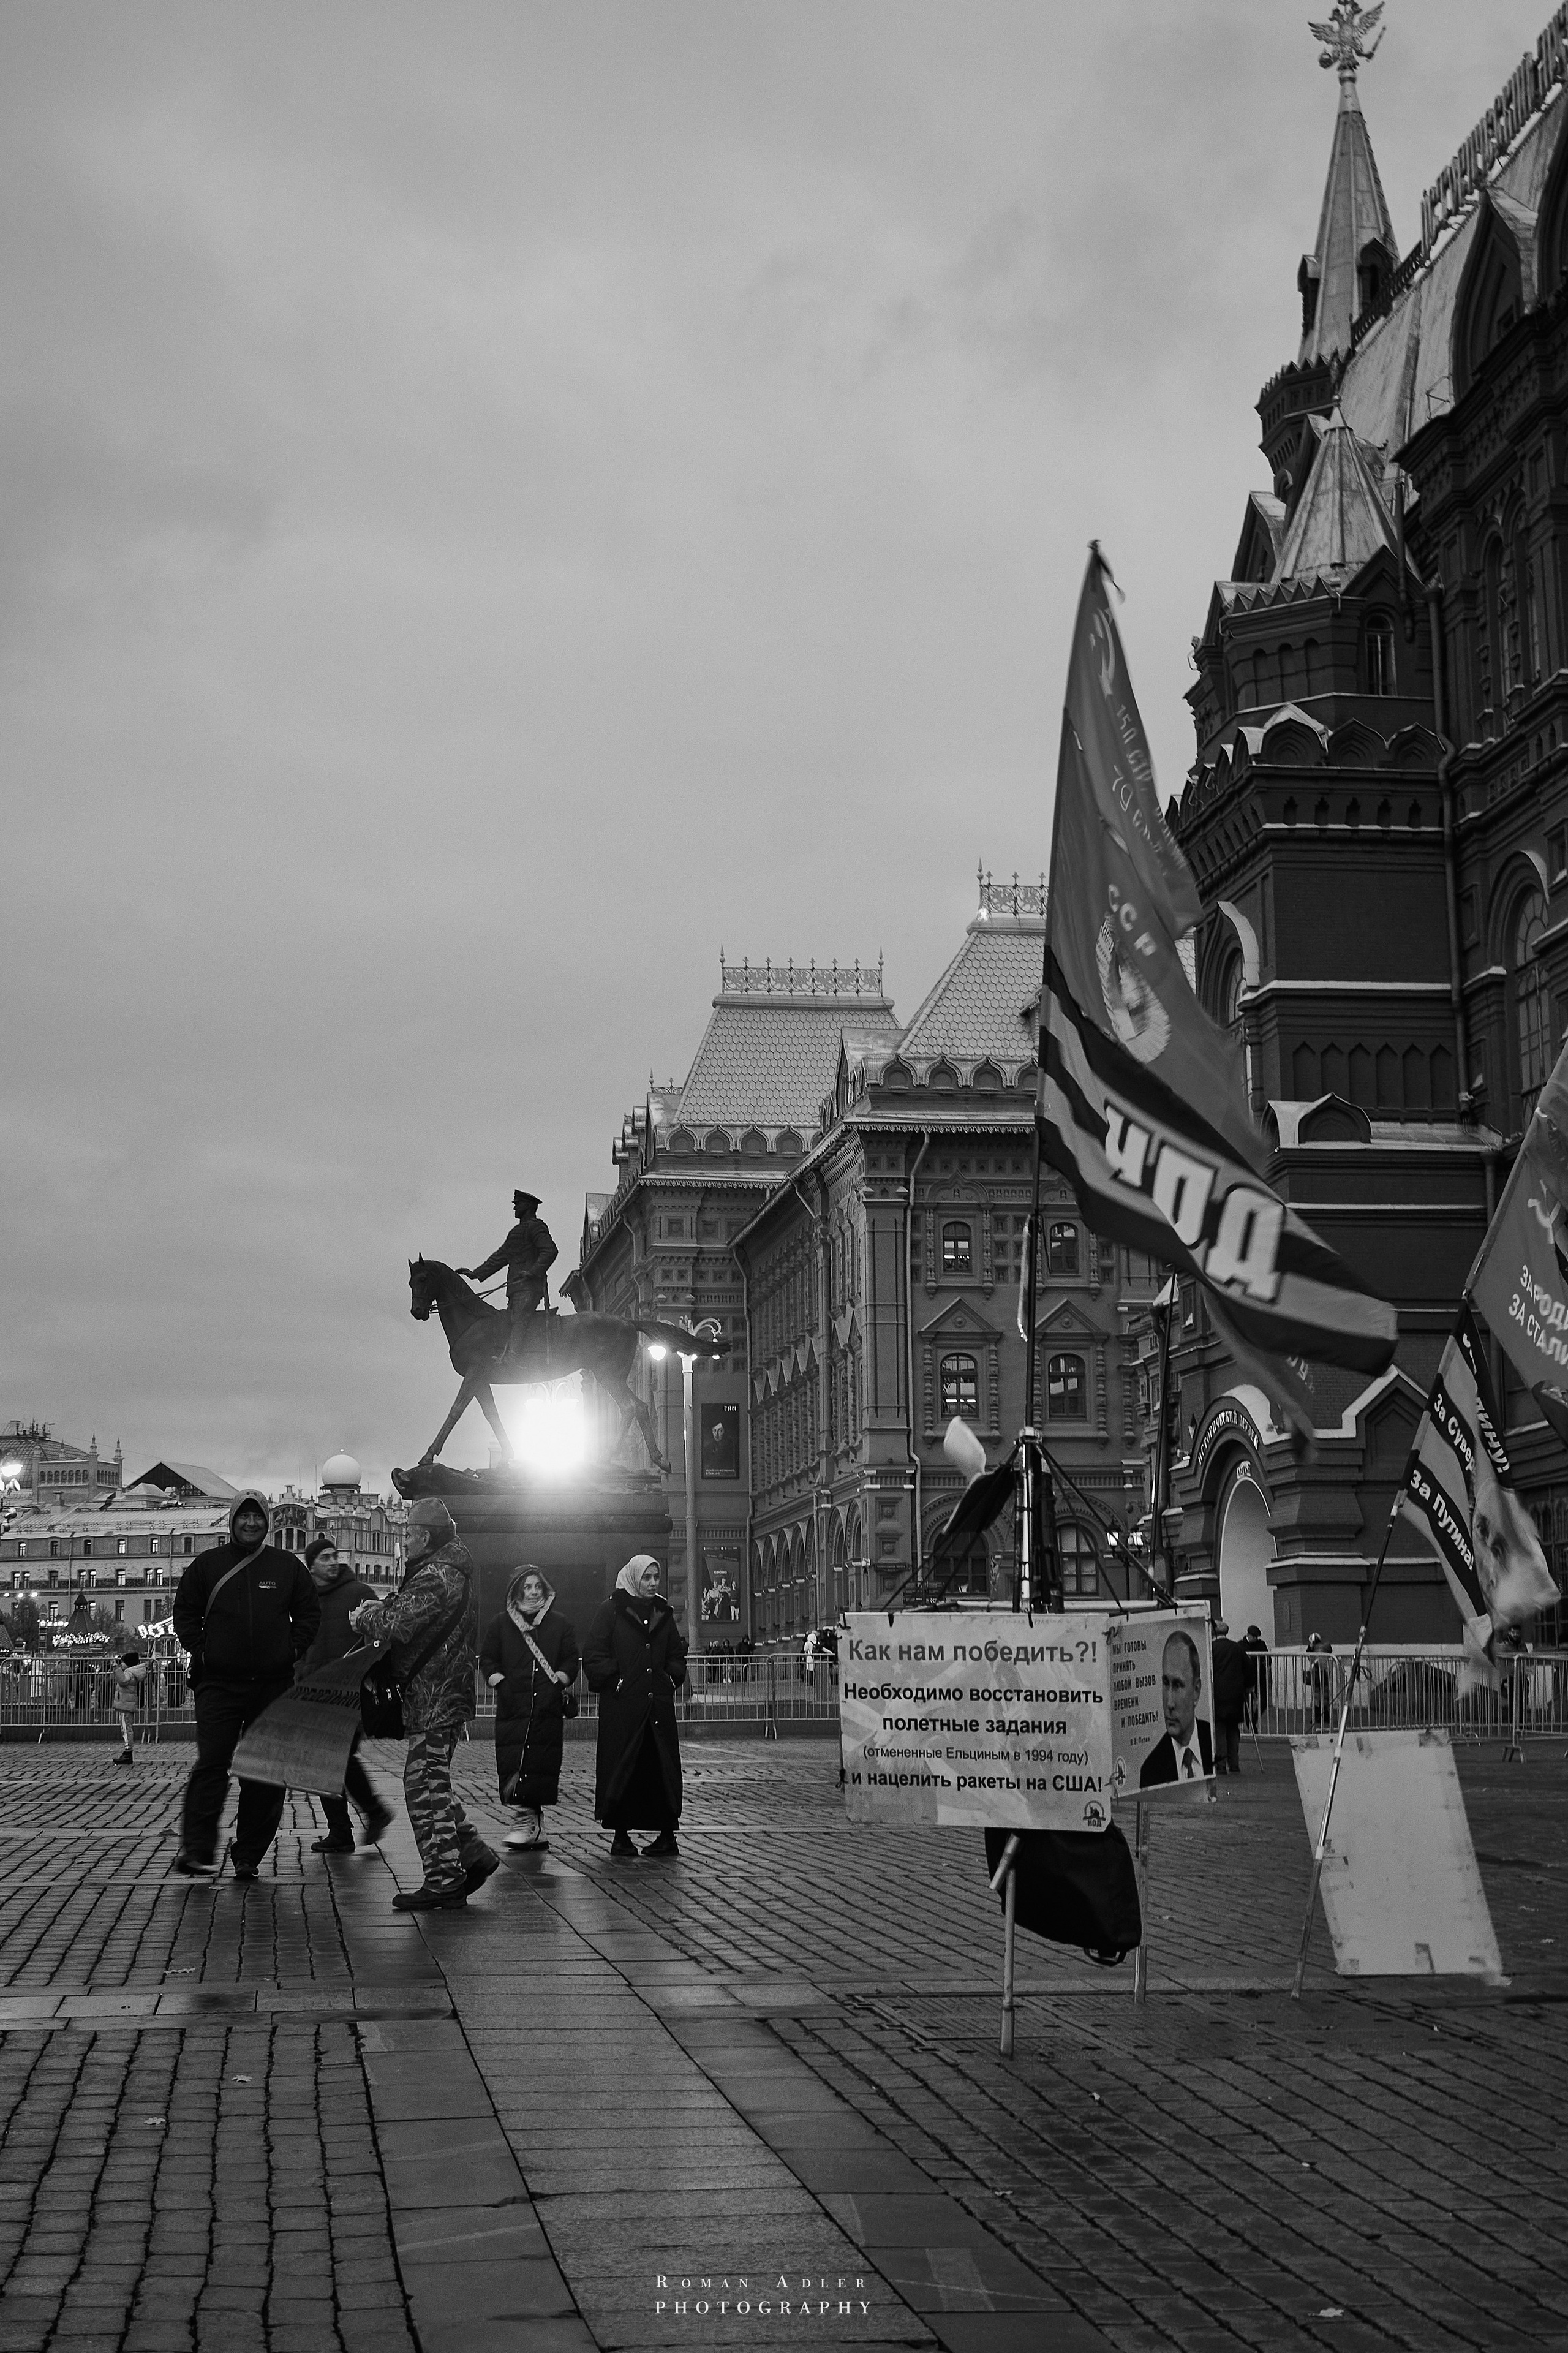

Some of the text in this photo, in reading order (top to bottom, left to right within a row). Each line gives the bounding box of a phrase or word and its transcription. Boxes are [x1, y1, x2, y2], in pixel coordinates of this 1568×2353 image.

[1434, 1393, 1446, 1422] За
[1411, 1470, 1474, 1571] За Путина!
[850, 1639, 1096, 1664] Как нам победить?!
[1125, 1640, 1147, 1653] ГОТОВЫ
[1136, 1675, 1156, 1688] ВЫЗОВ
[845, 1683, 1103, 1703] Необходимо восстановить
[1114, 1696, 1139, 1711] ВРЕМЕНИ
[883, 1718, 1066, 1736] полетные задания
[1128, 1710, 1158, 1726] ПОБЕДИТЬ!
[864, 1745, 1088, 1766] (отмененные Ельциным в 1994 году)
[852, 1773, 861, 1785] и
[868, 1773, 951, 1788] нацелить
[957, 1776, 1020, 1791] ракеты
[1027, 1778, 1046, 1790] на
[1053, 1775, 1101, 1792] США!
